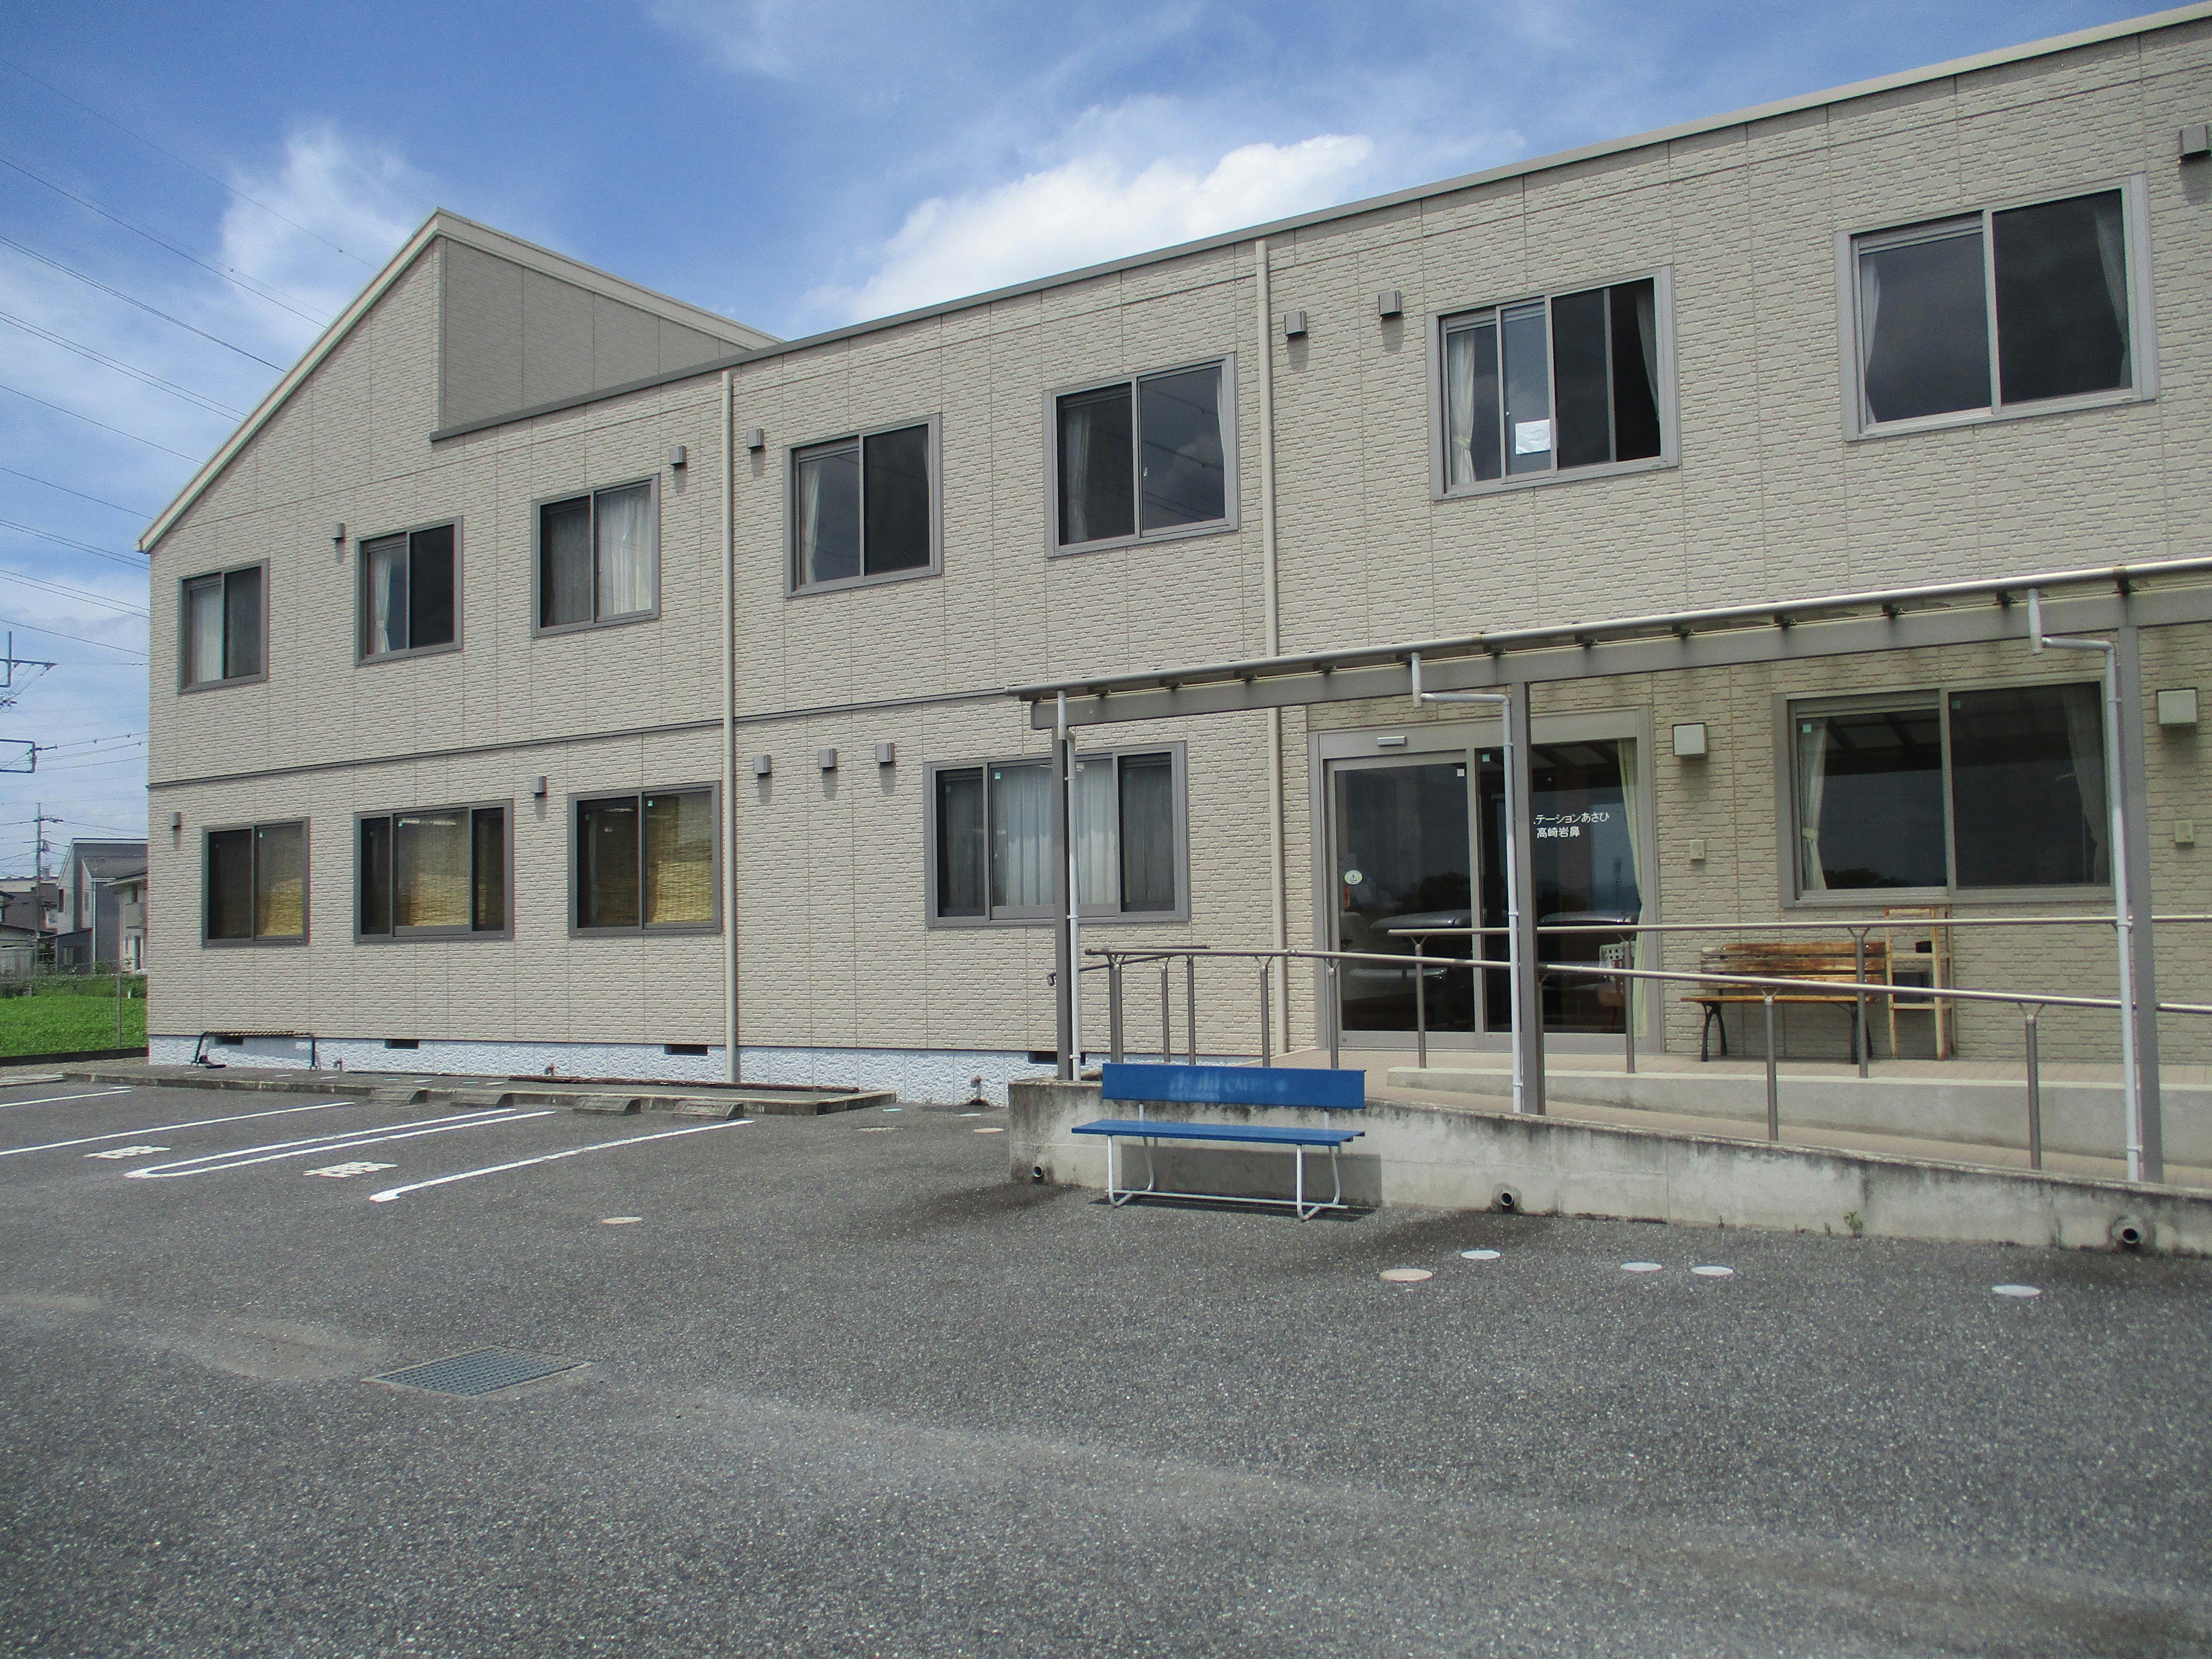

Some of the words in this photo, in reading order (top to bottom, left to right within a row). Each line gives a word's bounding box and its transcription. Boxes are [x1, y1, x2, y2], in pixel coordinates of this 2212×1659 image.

[1533, 812, 1609, 825] テーションあさひ
[1537, 826, 1580, 839] 高崎岩鼻
